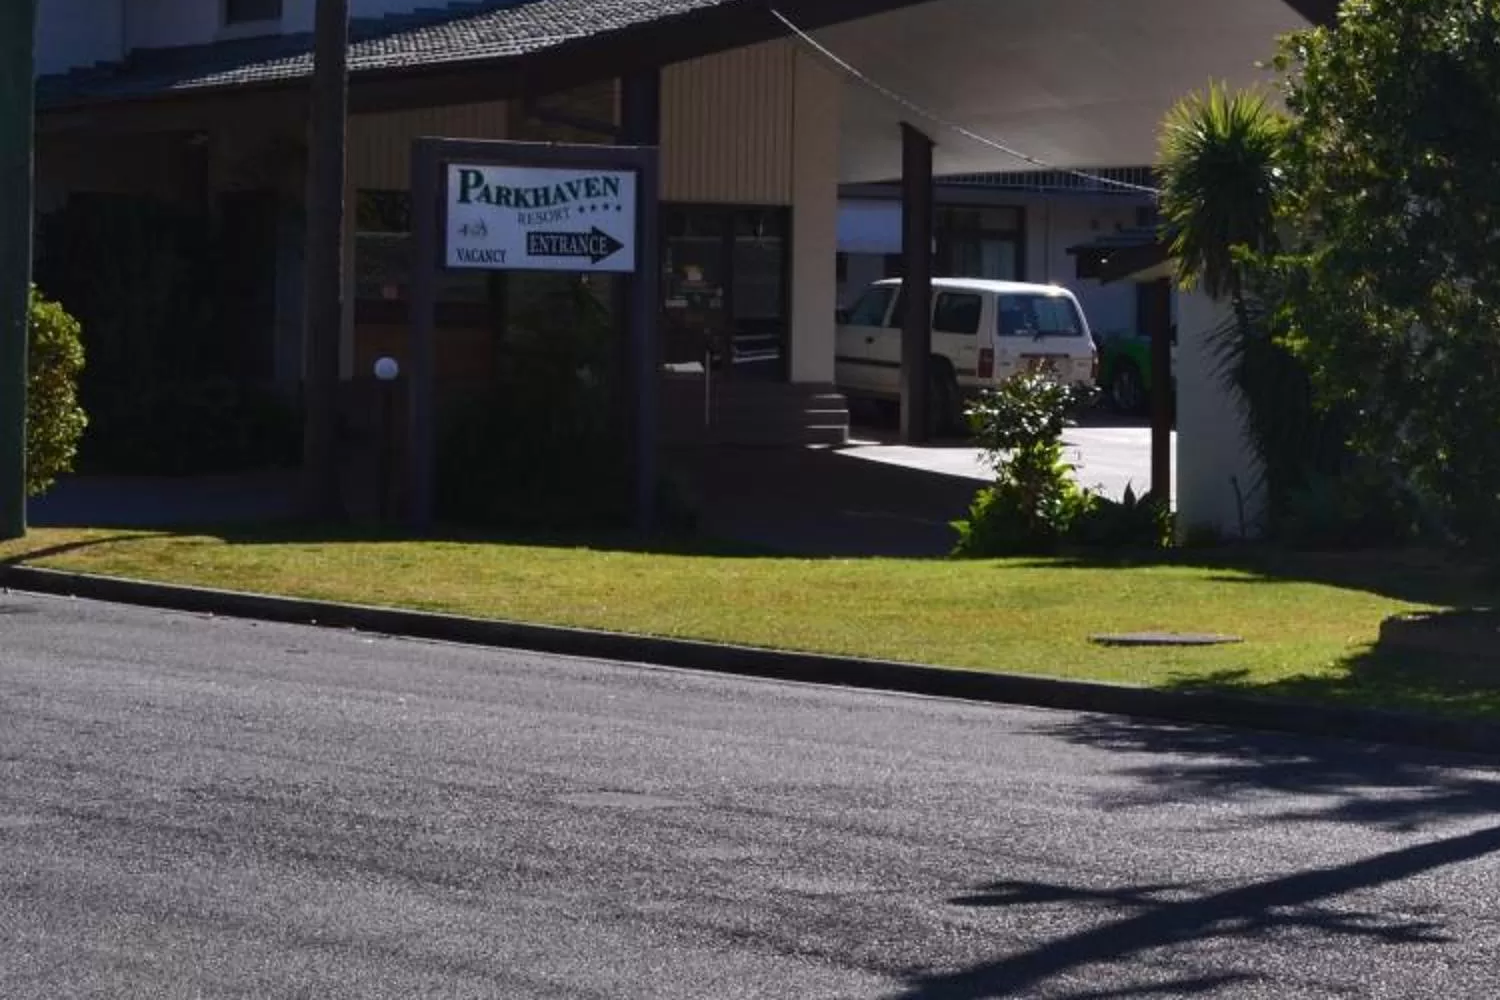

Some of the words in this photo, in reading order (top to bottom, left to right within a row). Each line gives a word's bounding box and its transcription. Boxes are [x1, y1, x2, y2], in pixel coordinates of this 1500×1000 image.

[457, 169, 621, 208] PARKHAVEN
[518, 207, 571, 225] RESORT
[530, 233, 609, 255] ENTRANCE
[456, 248, 506, 264] VACANCY
